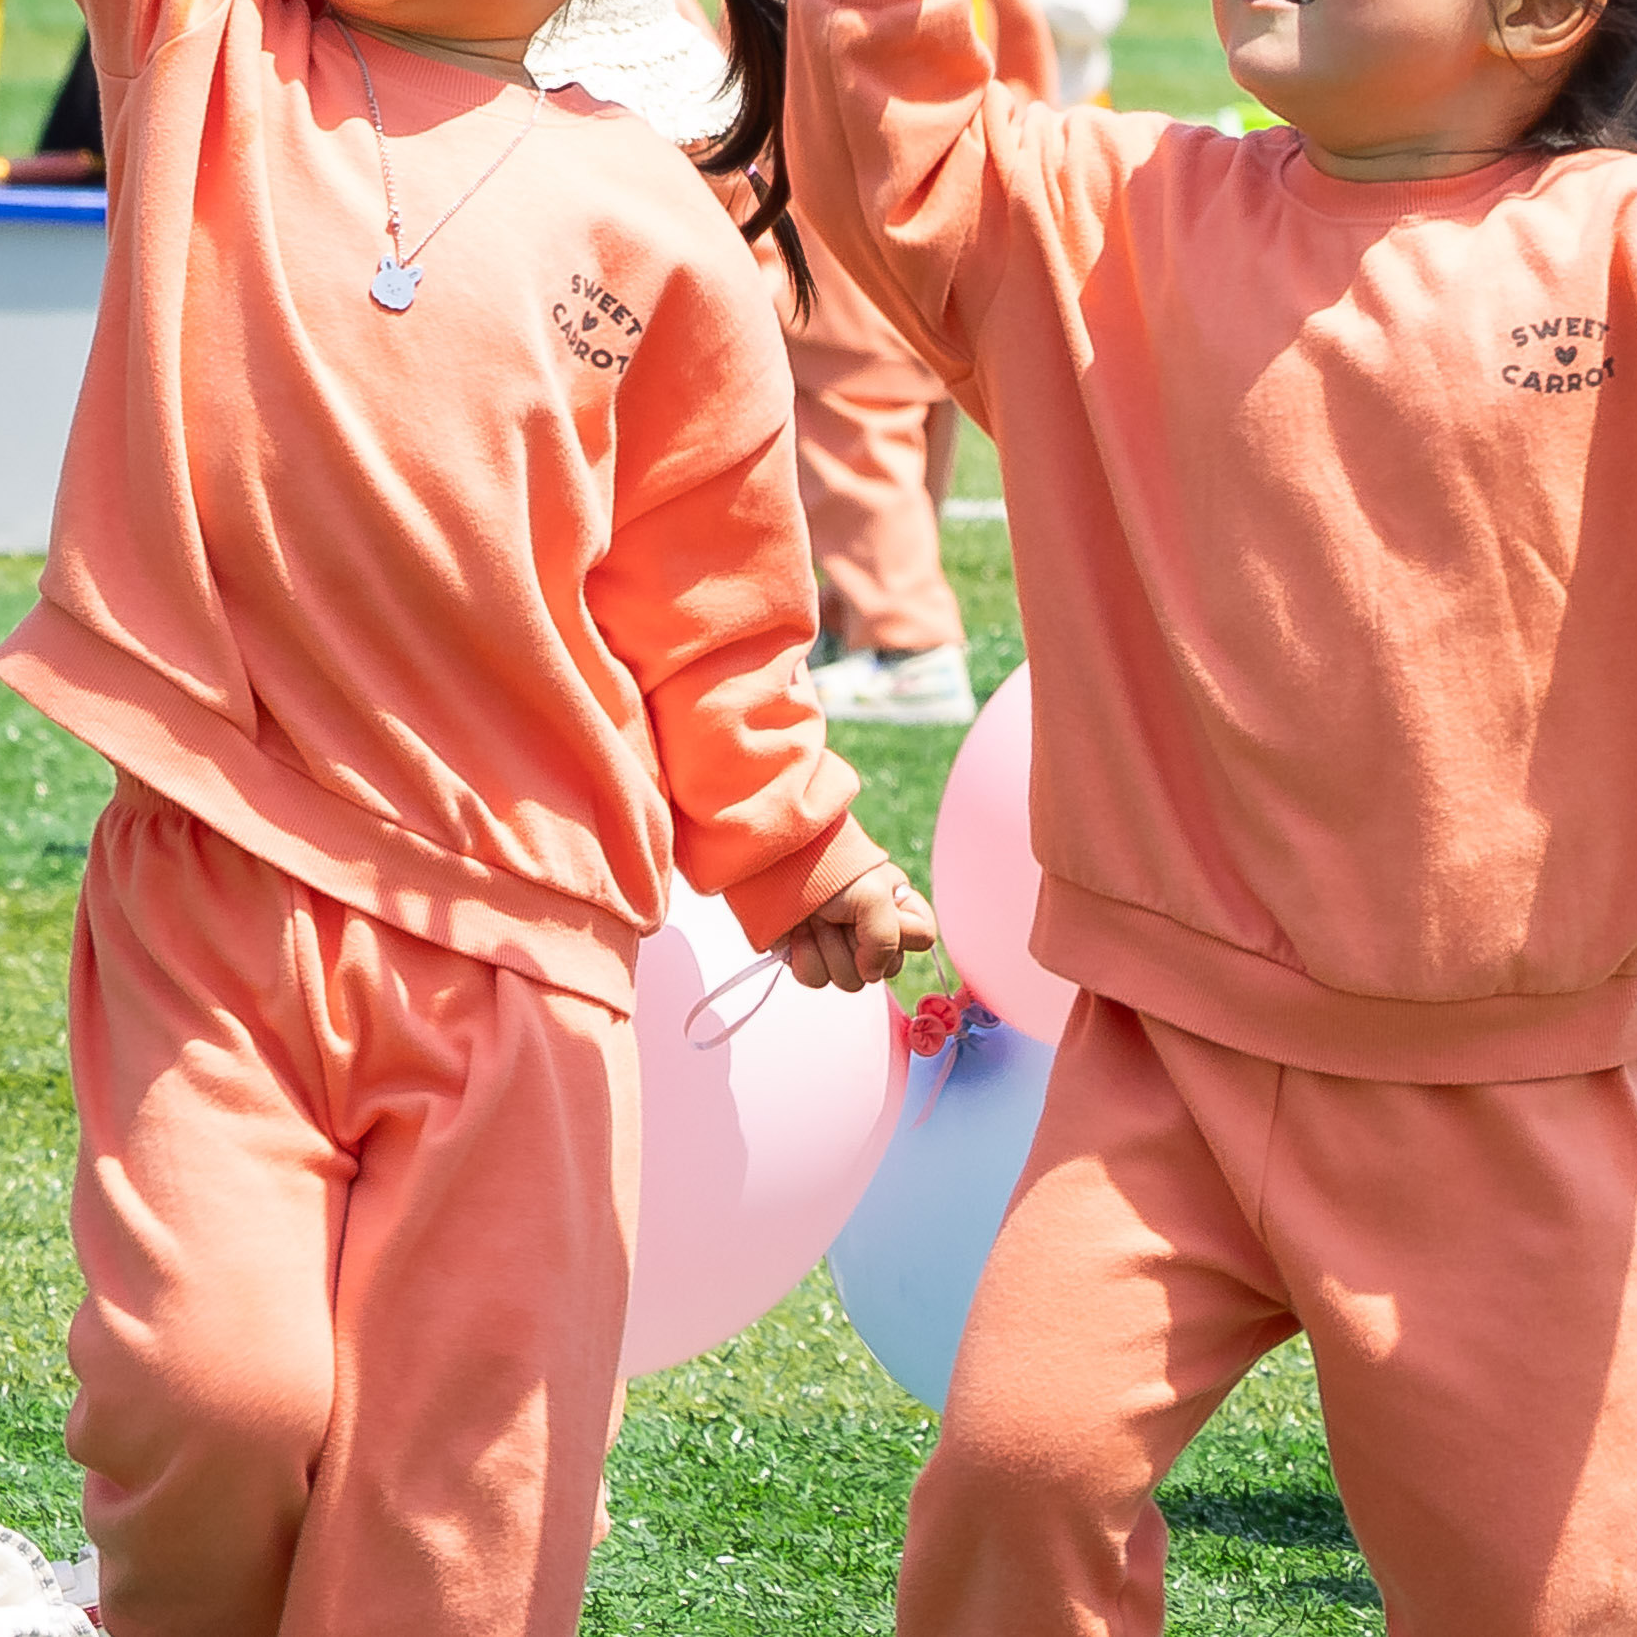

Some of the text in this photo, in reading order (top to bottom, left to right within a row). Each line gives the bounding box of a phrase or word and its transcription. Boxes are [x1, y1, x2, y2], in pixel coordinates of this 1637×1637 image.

[571, 273, 643, 337] SWEET
[552, 302, 630, 375] CARROT
[1511, 317, 1611, 348] SWEET
[1501, 356, 1616, 394] CARROT
